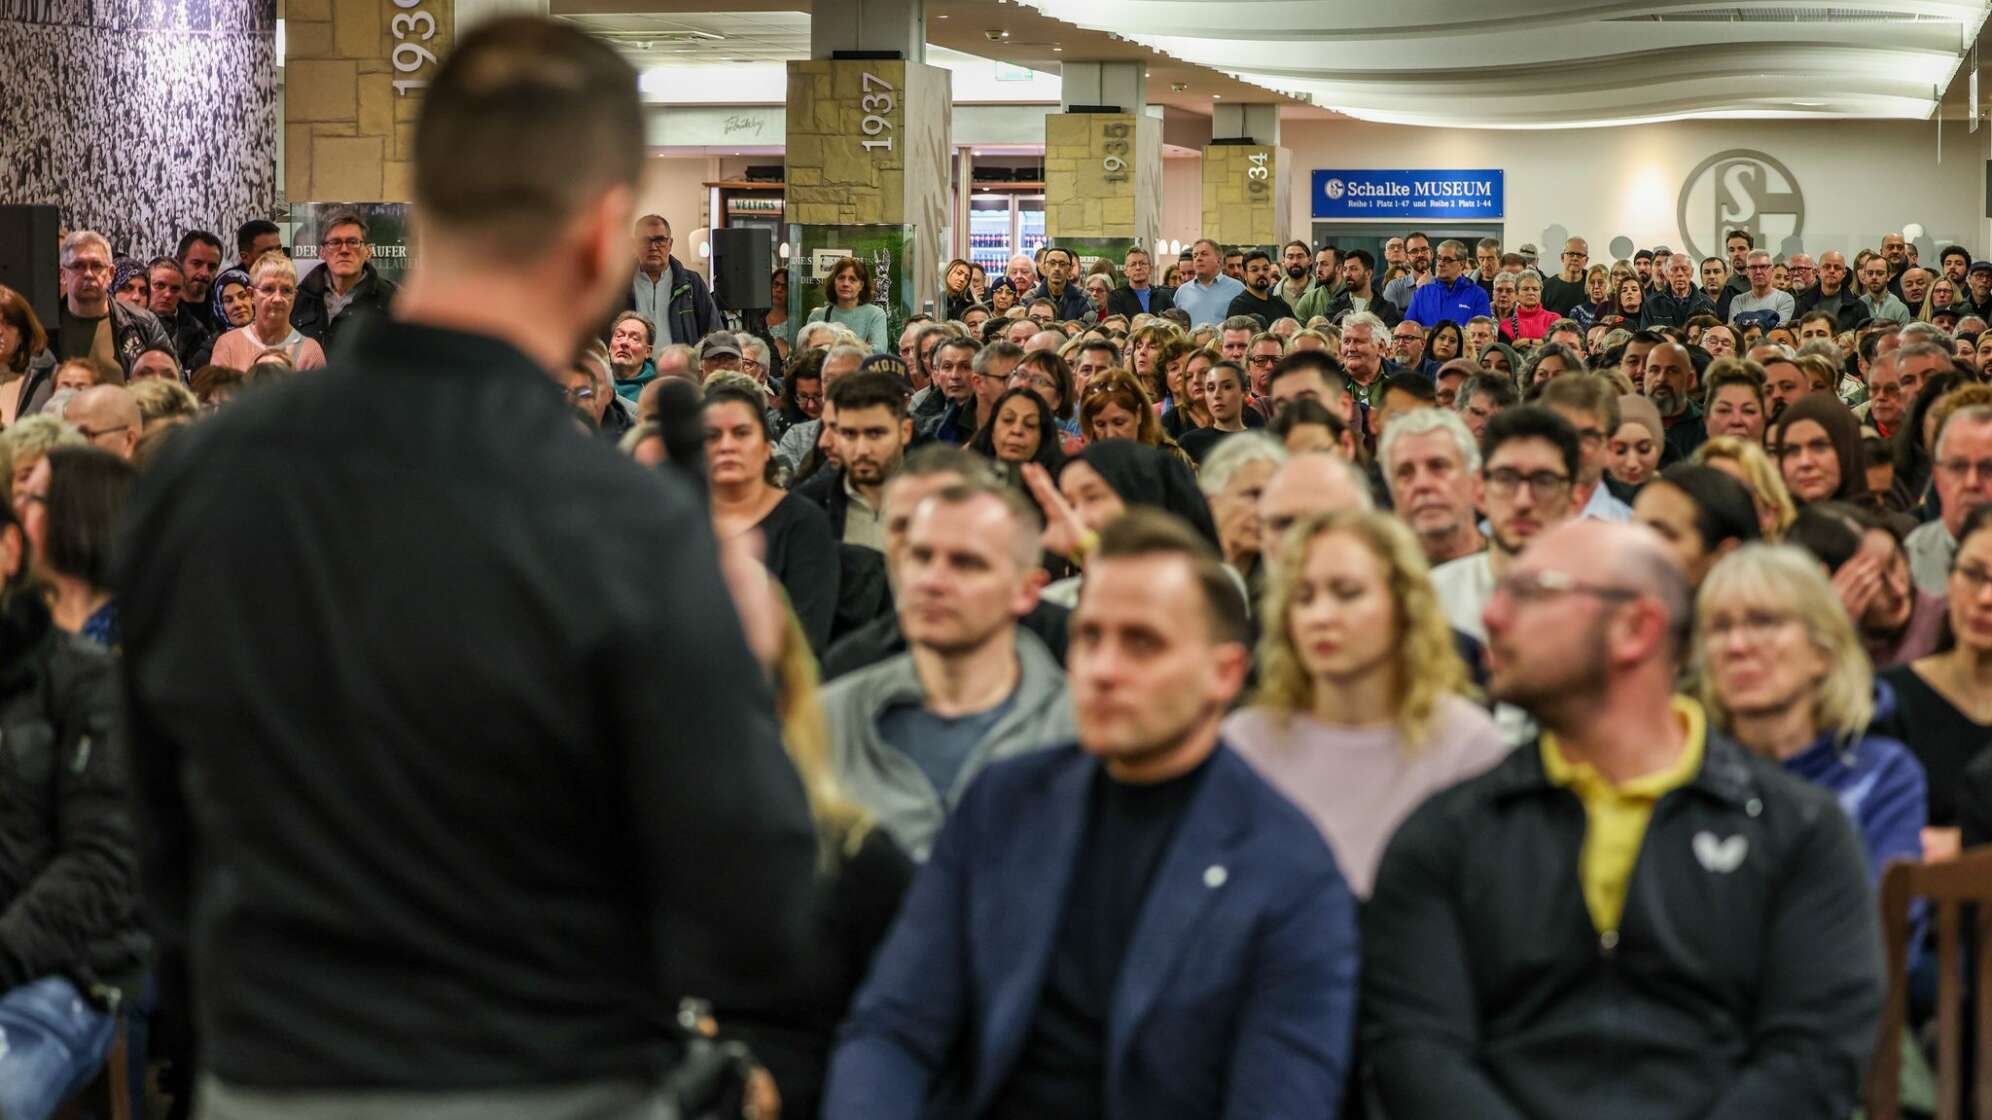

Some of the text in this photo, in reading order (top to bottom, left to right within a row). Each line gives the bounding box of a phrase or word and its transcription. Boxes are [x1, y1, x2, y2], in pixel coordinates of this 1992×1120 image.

[391, 0, 436, 96] 193
[861, 72, 893, 152] 1937
[1103, 123, 1129, 184] 1935
[1248, 152, 1269, 206] 1934
[1347, 181, 1410, 197] Schalke
[1414, 181, 1492, 197] MUSEUM
[1348, 200, 1367, 208] Reihe
[1376, 200, 1393, 208] Platz
[1413, 200, 1426, 208] und
[1430, 200, 1449, 208] Reihe
[1458, 200, 1475, 208] Platz
[295, 245, 318, 257] DER
[868, 358, 905, 377] MOIN
